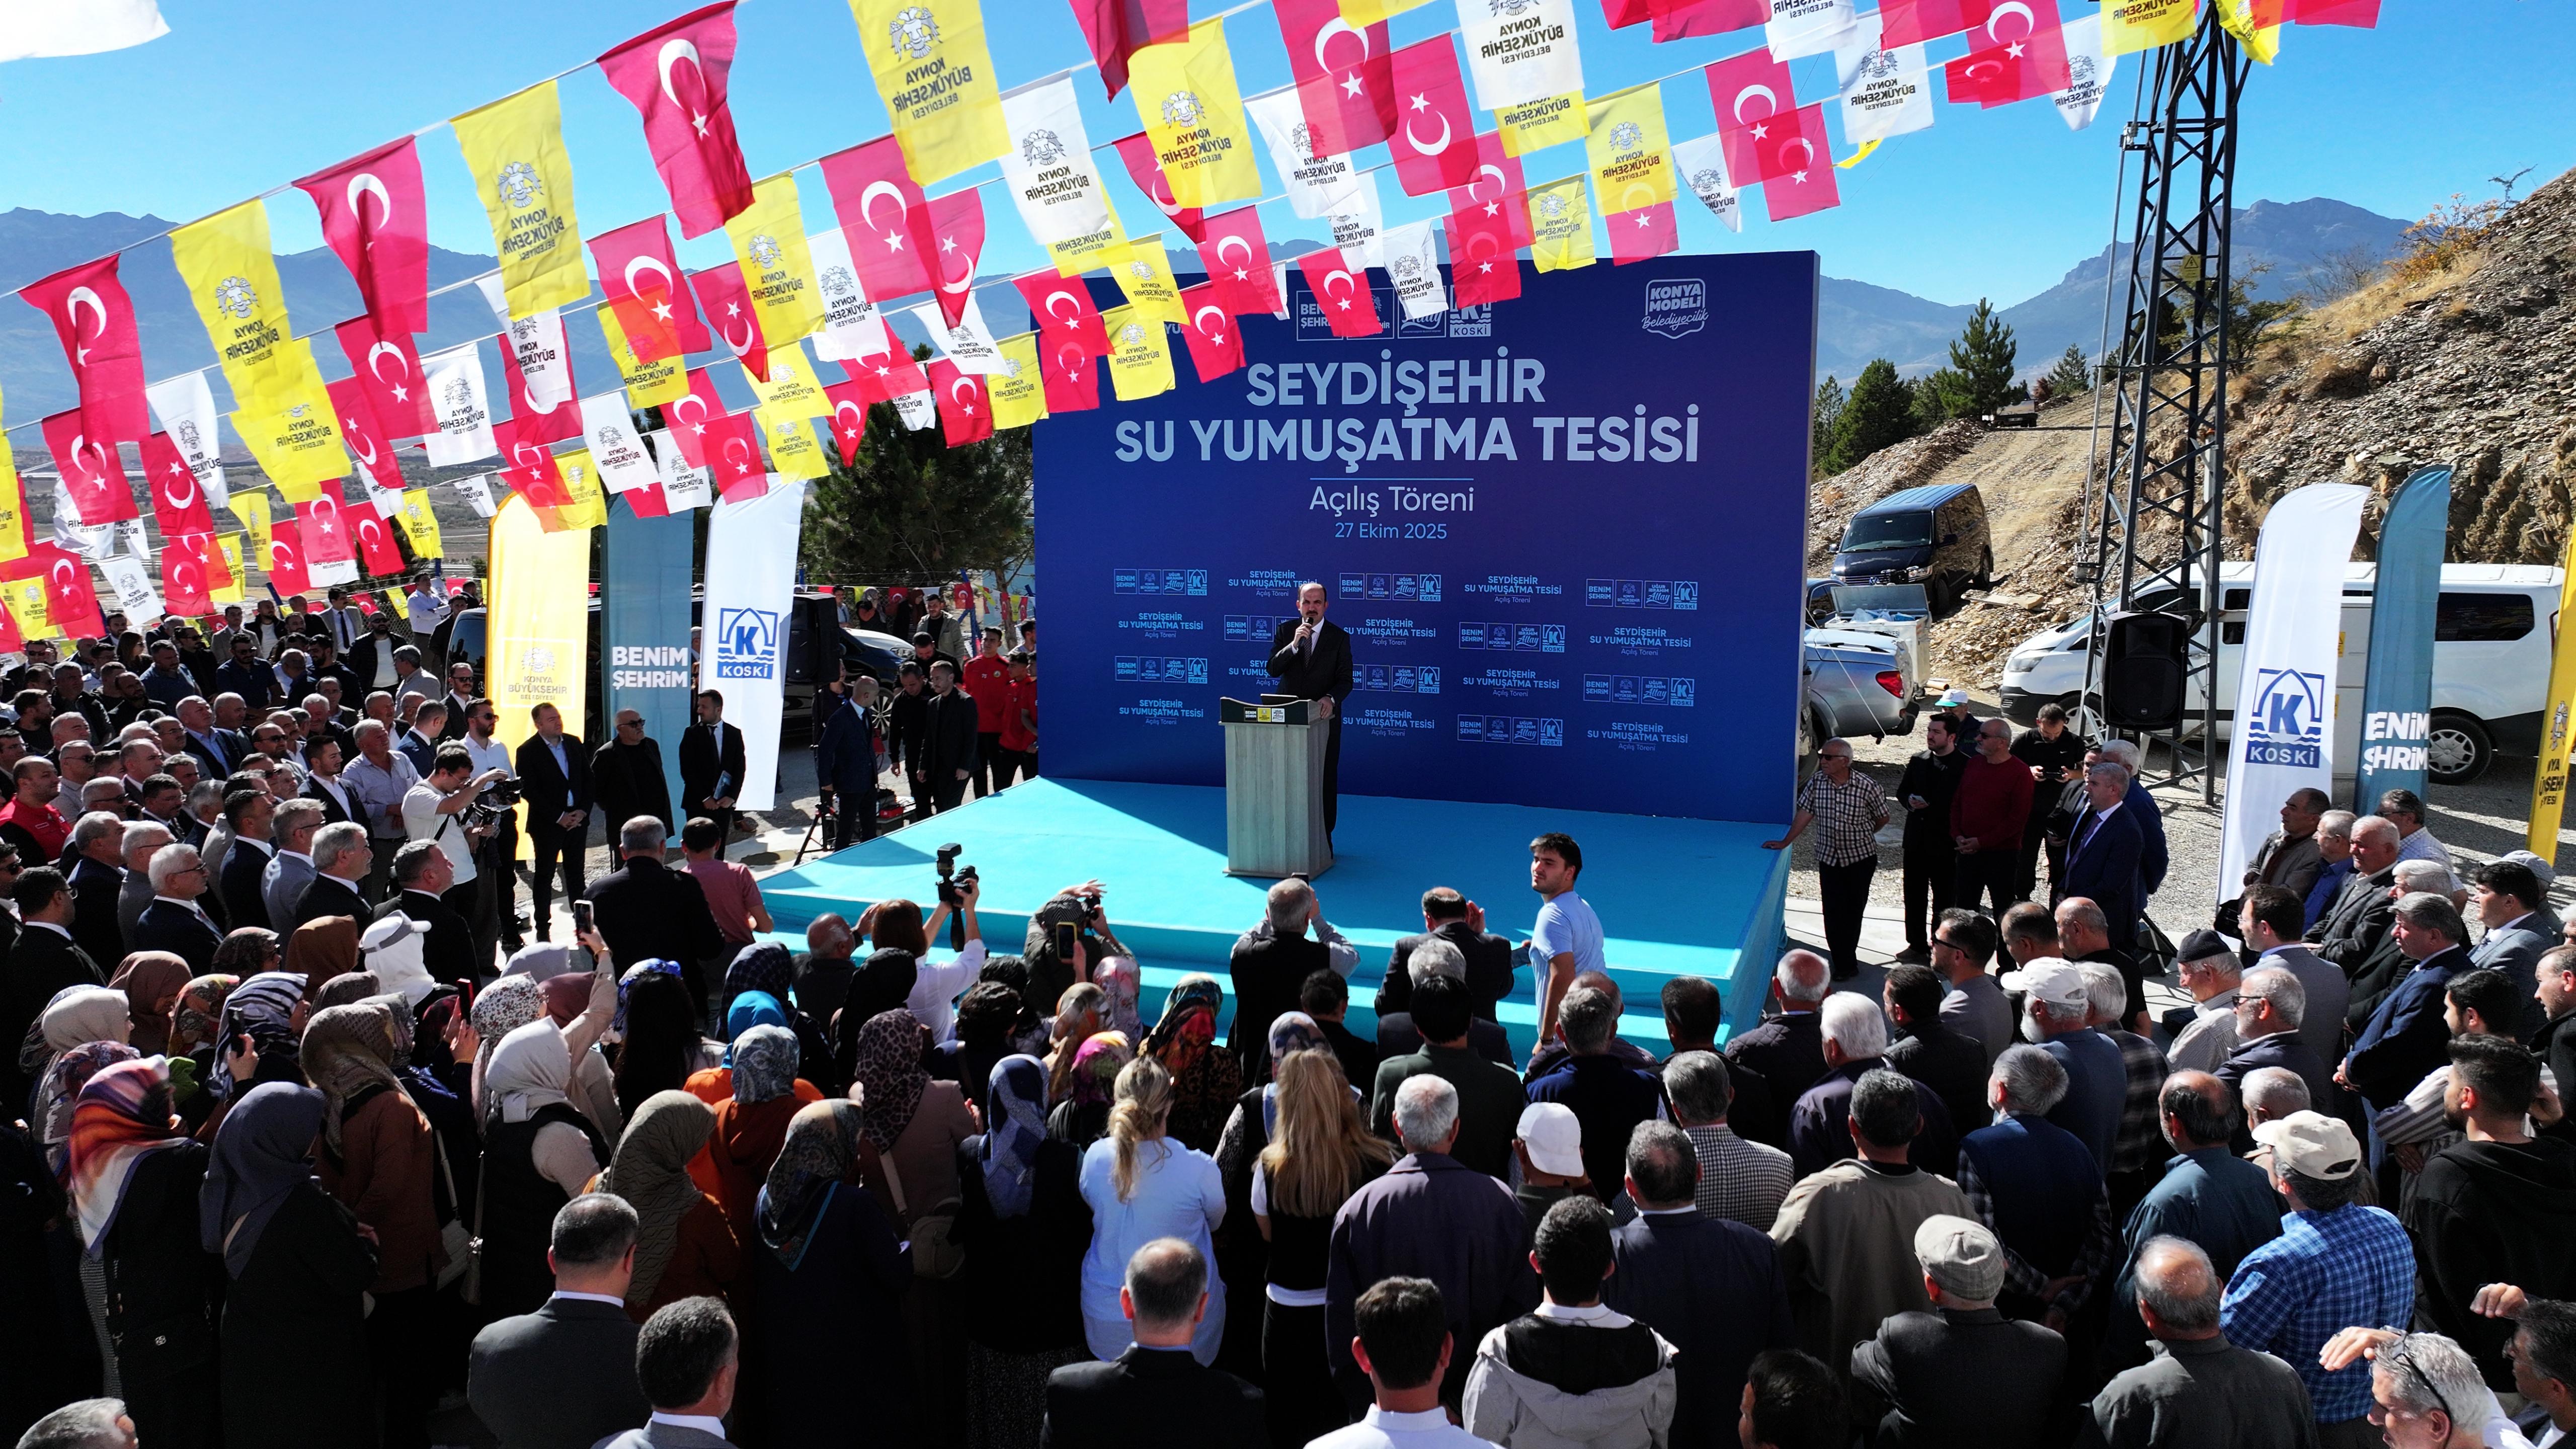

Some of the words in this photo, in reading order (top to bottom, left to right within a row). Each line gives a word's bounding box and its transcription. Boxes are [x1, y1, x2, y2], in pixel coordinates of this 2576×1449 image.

[1650, 283, 1702, 300] KONYA
[1649, 296, 1701, 312] MODELİ
[1641, 308, 1709, 331] Belediyecilik
[1454, 327, 1487, 336] KOSKİ
[1246, 346, 1546, 417] SEYDİŞEHİR
[1114, 421, 1173, 462] SU
[1190, 418, 1518, 473] YUMUŞATMA
[1533, 404, 1699, 462] TESİSİ
[1310, 485, 1379, 517] Açılış
[1386, 485, 1475, 512] Töreni
[1335, 523, 1353, 538] 27
[1358, 522, 1401, 539] Ekim
[1405, 522, 1448, 539] 2025
[1250, 569, 1296, 580] SEYDİŞEHİR
[1488, 575, 1538, 585] SEYDİŞEHİR
[1241, 580, 1292, 588] YUMUŞATMA
[1478, 585, 1534, 594] YUMUŞATMA
[1536, 585, 1562, 594] TESİSİ
[1139, 612, 1182, 621] SEYDİŞEHİR
[1130, 621, 1178, 630] YUMUŞATMA
[1180, 621, 1203, 629] TESİSİ
[1365, 618, 1413, 628] SEYDİŞEHİR
[1356, 627, 1409, 637] YUMUŞATMA
[1411, 628, 1436, 637] TESİSİ
[1614, 626, 1666, 638] SEYDİŞEHİR
[1589, 635, 1601, 643] SU
[1604, 636, 1662, 647] YUMUŞATMA
[1664, 637, 1691, 647] TESİSİ
[612, 647, 688, 667] BENİM
[722, 665, 768, 678] KOSKİ
[1486, 668, 1536, 679] SEYDİŞEHİR
[524, 675, 553, 684] KONYA
[613, 670, 688, 690] ŞEHRİM
[1476, 678, 1531, 688] YUMUŞATMA
[1534, 679, 1559, 688] TESİSİ
[508, 683, 567, 695] BÜYÜKŞEHİR
[1140, 698, 1182, 708] SEYDİŞEHİR
[1131, 707, 1179, 716] YUMUŞATMA
[1181, 708, 1203, 717] TESİSİ
[1365, 708, 1412, 719] SEYDİŞEHİR
[1355, 717, 1408, 728] YUMUŞATMA
[1410, 719, 1434, 729] TESİSİ
[1612, 722, 1663, 734] SEYDİŞEHİR
[1587, 730, 1598, 738] SU
[1601, 731, 1658, 742] YUMUŞATMA
[1660, 733, 1688, 743] TESİSİ
[2250, 745, 2315, 766] KOSKİ
